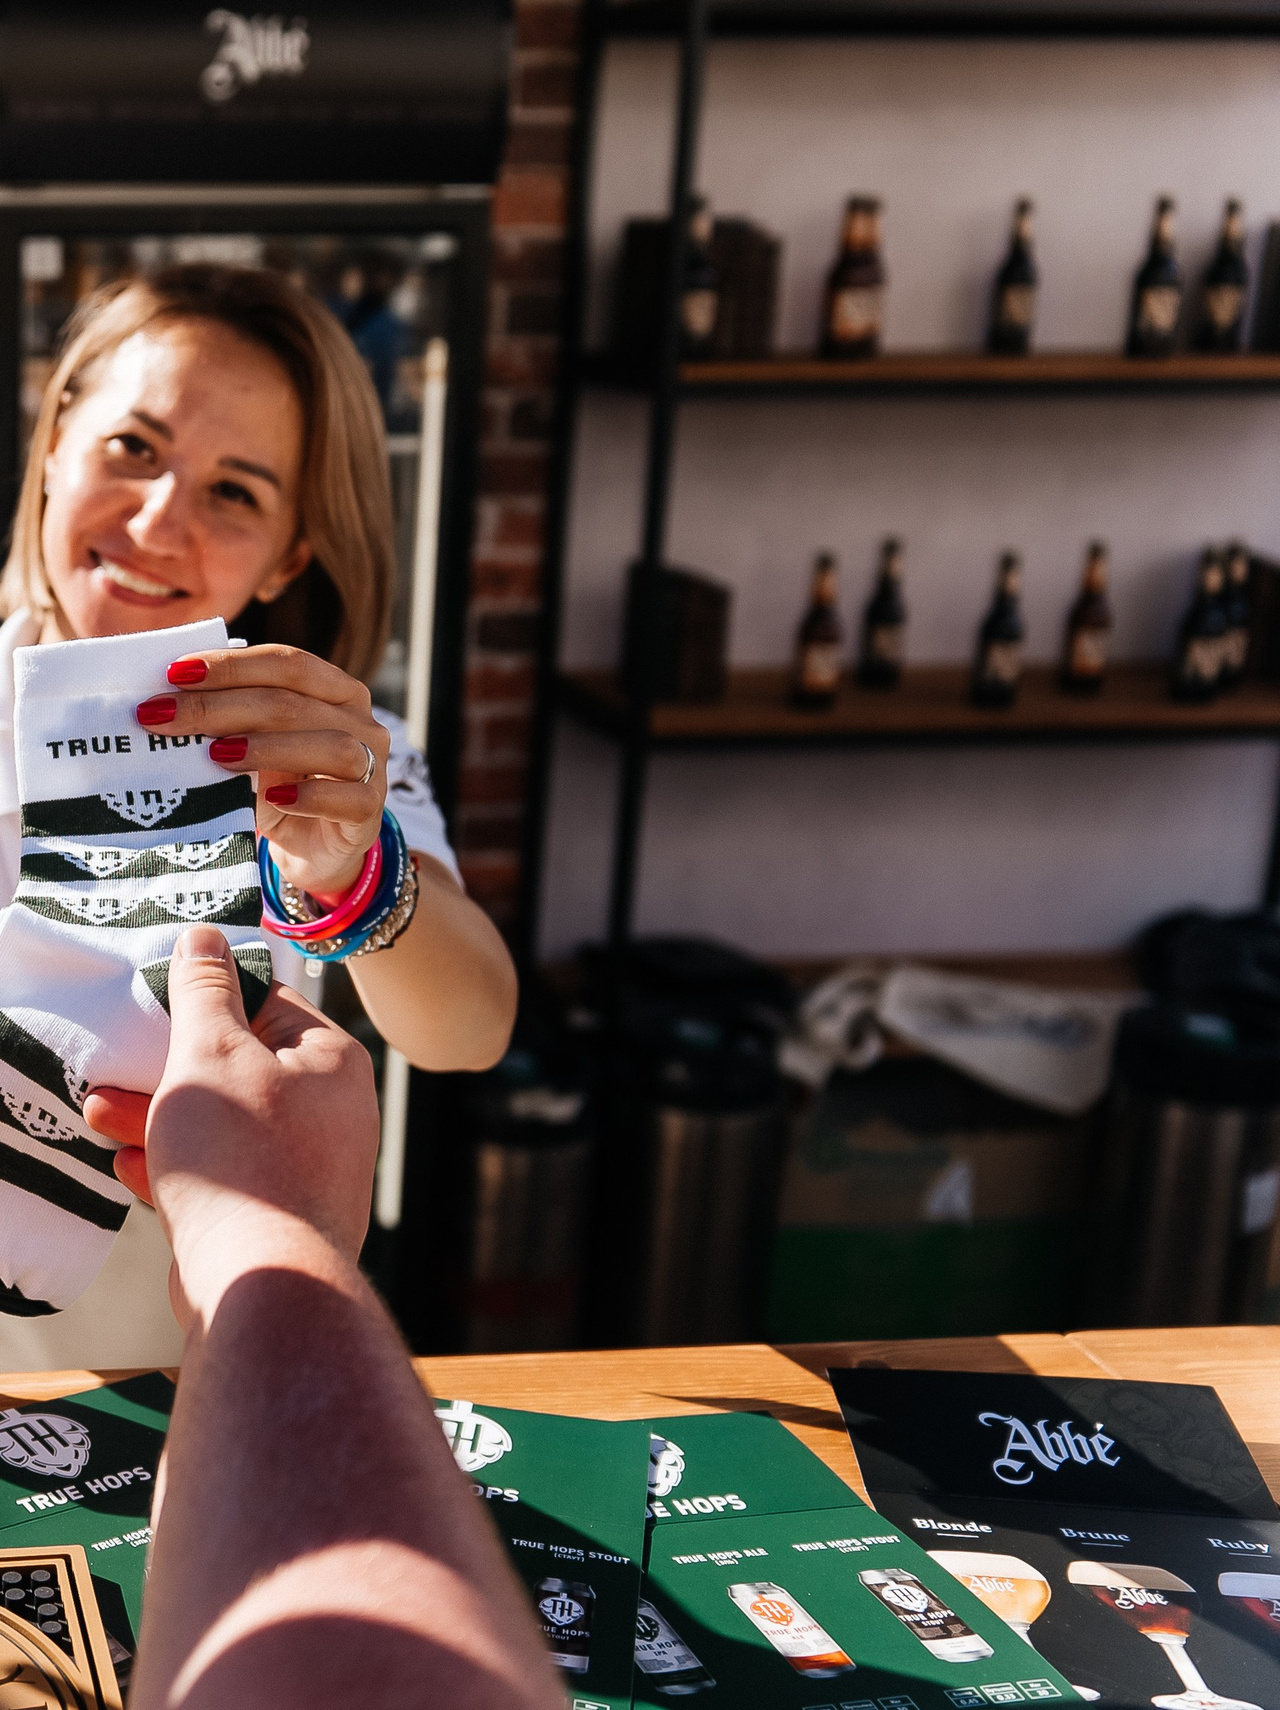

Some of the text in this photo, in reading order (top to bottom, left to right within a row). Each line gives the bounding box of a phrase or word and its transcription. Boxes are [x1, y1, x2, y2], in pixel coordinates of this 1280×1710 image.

[46, 733, 211, 759] TRUE HO
[978, 1411, 1121, 1485] Abbé
[16, 1466, 152, 1513] TRUE HOPS
[472, 1484, 520, 1502] OPS
[672, 1493, 747, 1516] HOPS
[912, 1517, 993, 1535] Blonde
[1060, 1527, 1131, 1543] Brune
[91, 1527, 154, 1552] TRUE HOPS
[791, 1535, 901, 1553] TRUE HOPS STOUT
[1207, 1538, 1270, 1554] Ruby
[512, 1538, 631, 1565] TRUE HOPS STOUT
[672, 1547, 769, 1565] TRUE HOPS ALE
[1107, 1585, 1169, 1610] Abbé
[898, 1609, 956, 1623] TRUE HOPS
[921, 1619, 945, 1627] STOUT
[537, 1624, 590, 1638] RUE HOPS
[763, 1624, 821, 1637] TRUE HOPS
[634, 1643, 655, 1652] RUE
